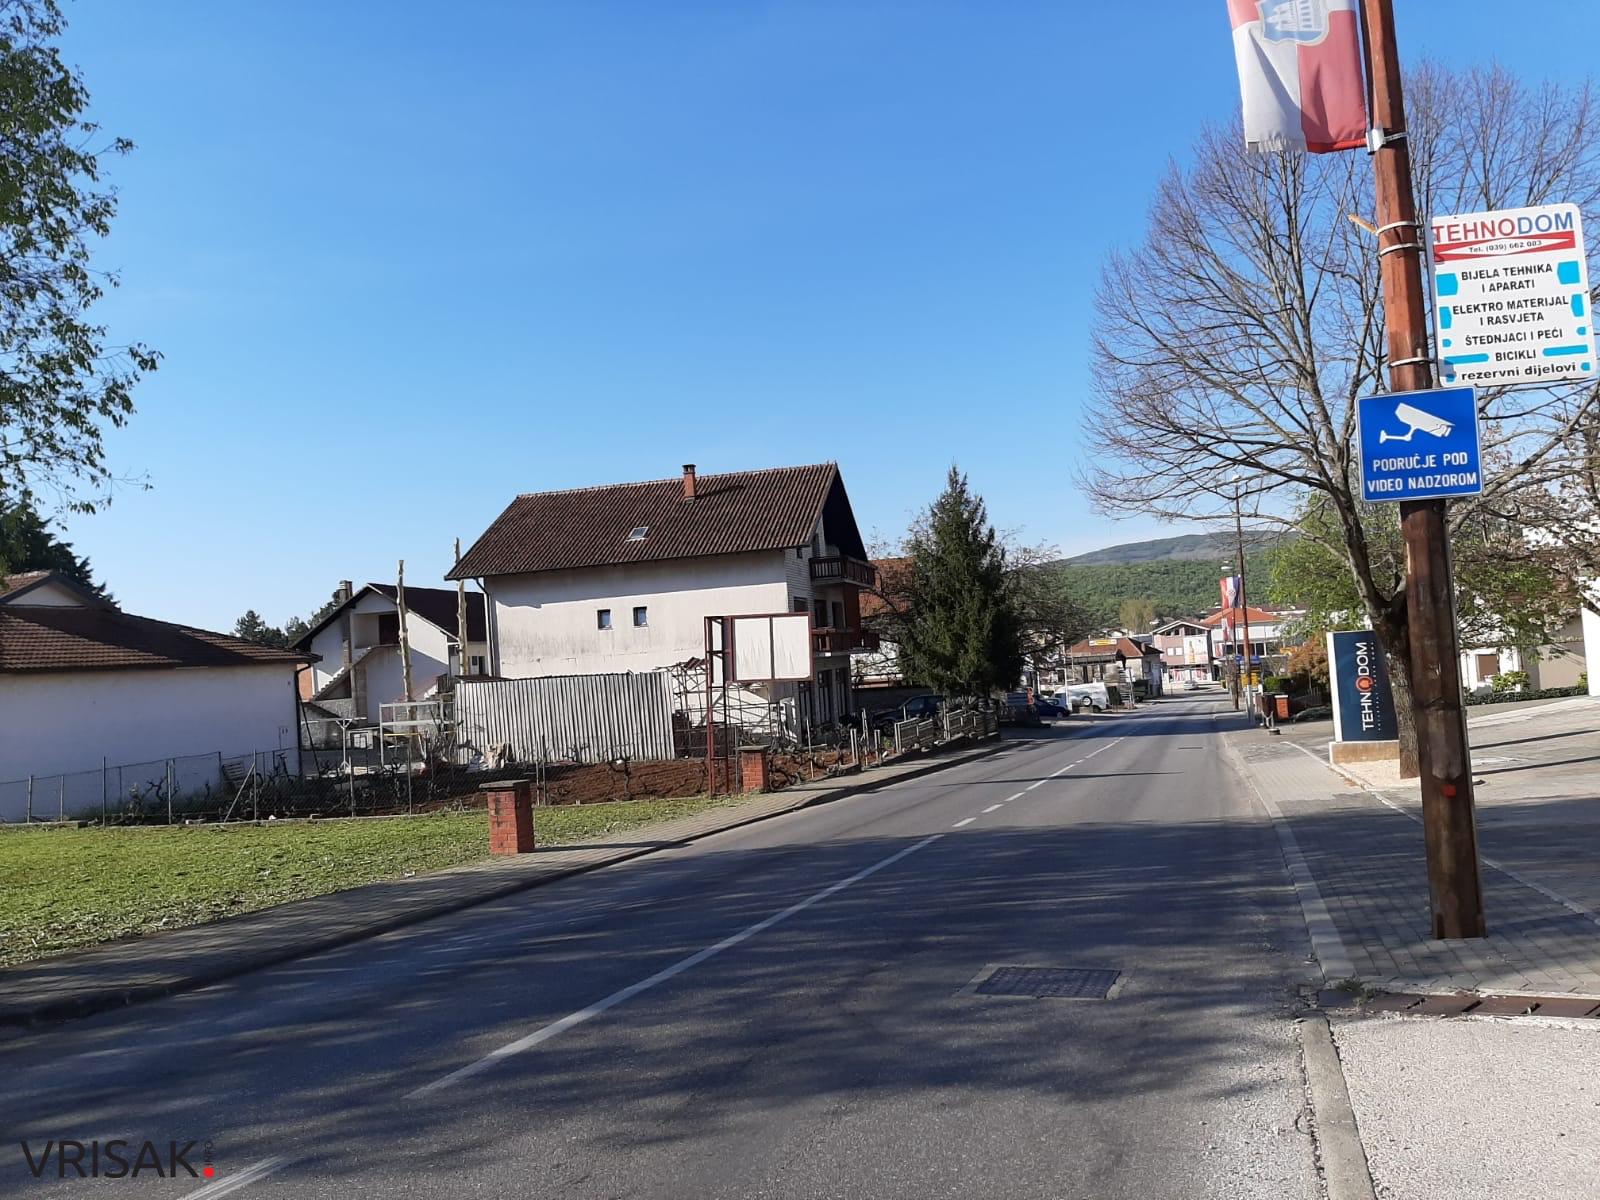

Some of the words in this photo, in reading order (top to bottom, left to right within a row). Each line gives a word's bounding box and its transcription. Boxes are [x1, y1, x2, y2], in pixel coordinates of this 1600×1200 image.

[1432, 212, 1573, 243] TEHNODOM
[1461, 269, 1500, 281] BIJELA
[1503, 263, 1553, 277] TEHNIKA
[1489, 280, 1535, 293] APARATI
[1453, 302, 1504, 315] ELEKTRO
[1507, 296, 1569, 310] MATERIJAL
[1487, 312, 1545, 325] RASVJETA
[1465, 332, 1527, 346] ŠTEDNJACI
[1495, 349, 1537, 361] BICIKLI
[1461, 369, 1520, 380] rezervni
[1525, 362, 1576, 376] dijelovi
[1373, 453, 1437, 472] PODRUČJE
[1443, 452, 1468, 466] POD
[1367, 478, 1403, 492] VIDEO
[1408, 472, 1477, 489] NADZOROM
